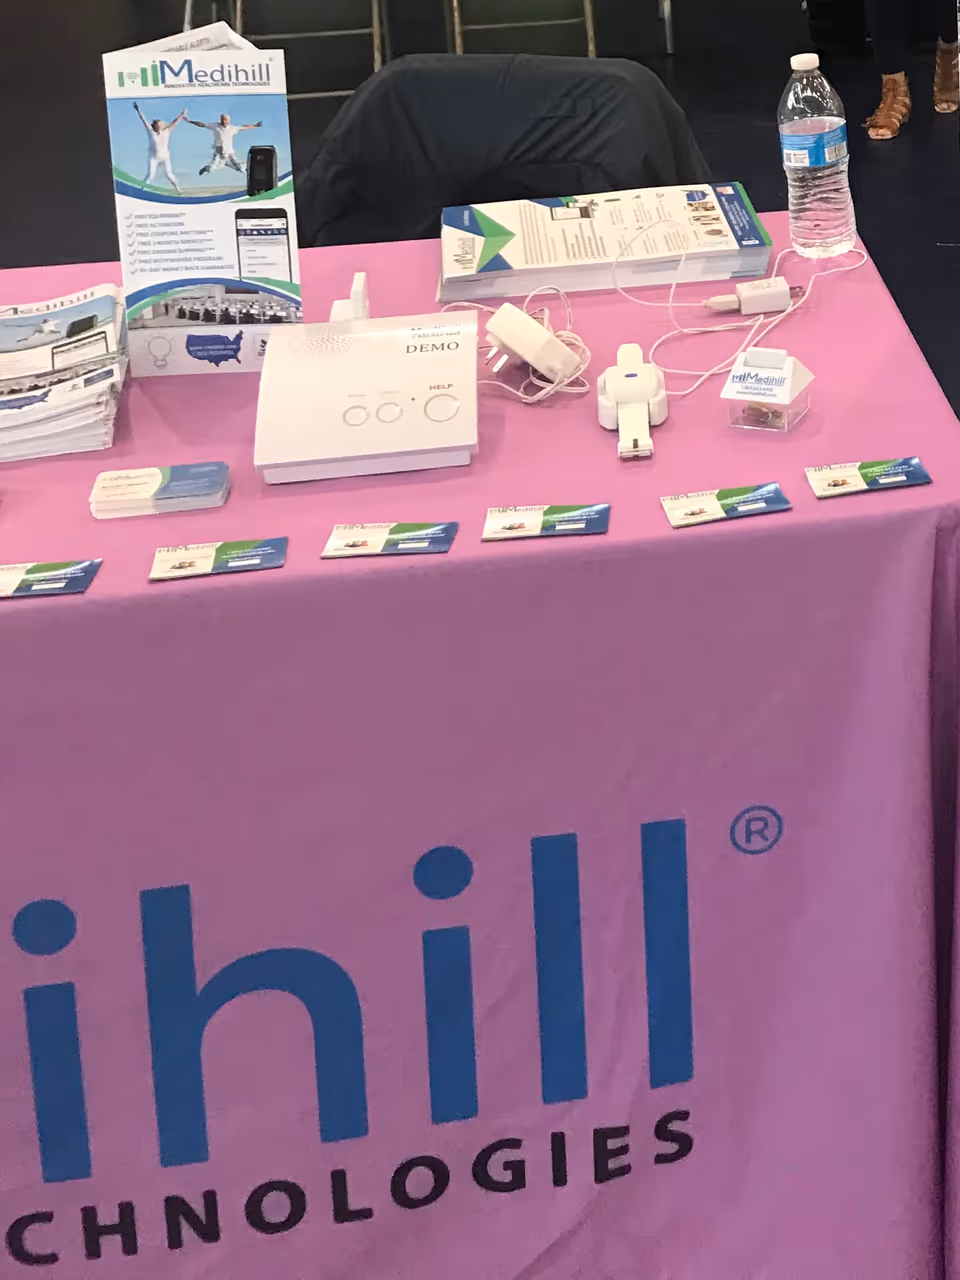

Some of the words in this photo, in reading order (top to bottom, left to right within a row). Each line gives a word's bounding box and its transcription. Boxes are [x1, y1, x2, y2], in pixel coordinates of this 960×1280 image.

[159, 59, 270, 84] Medihill
[406, 341, 459, 354] DEMO
[429, 383, 453, 391] HELP
[4, 1109, 695, 1266] CHNOLOGIES
